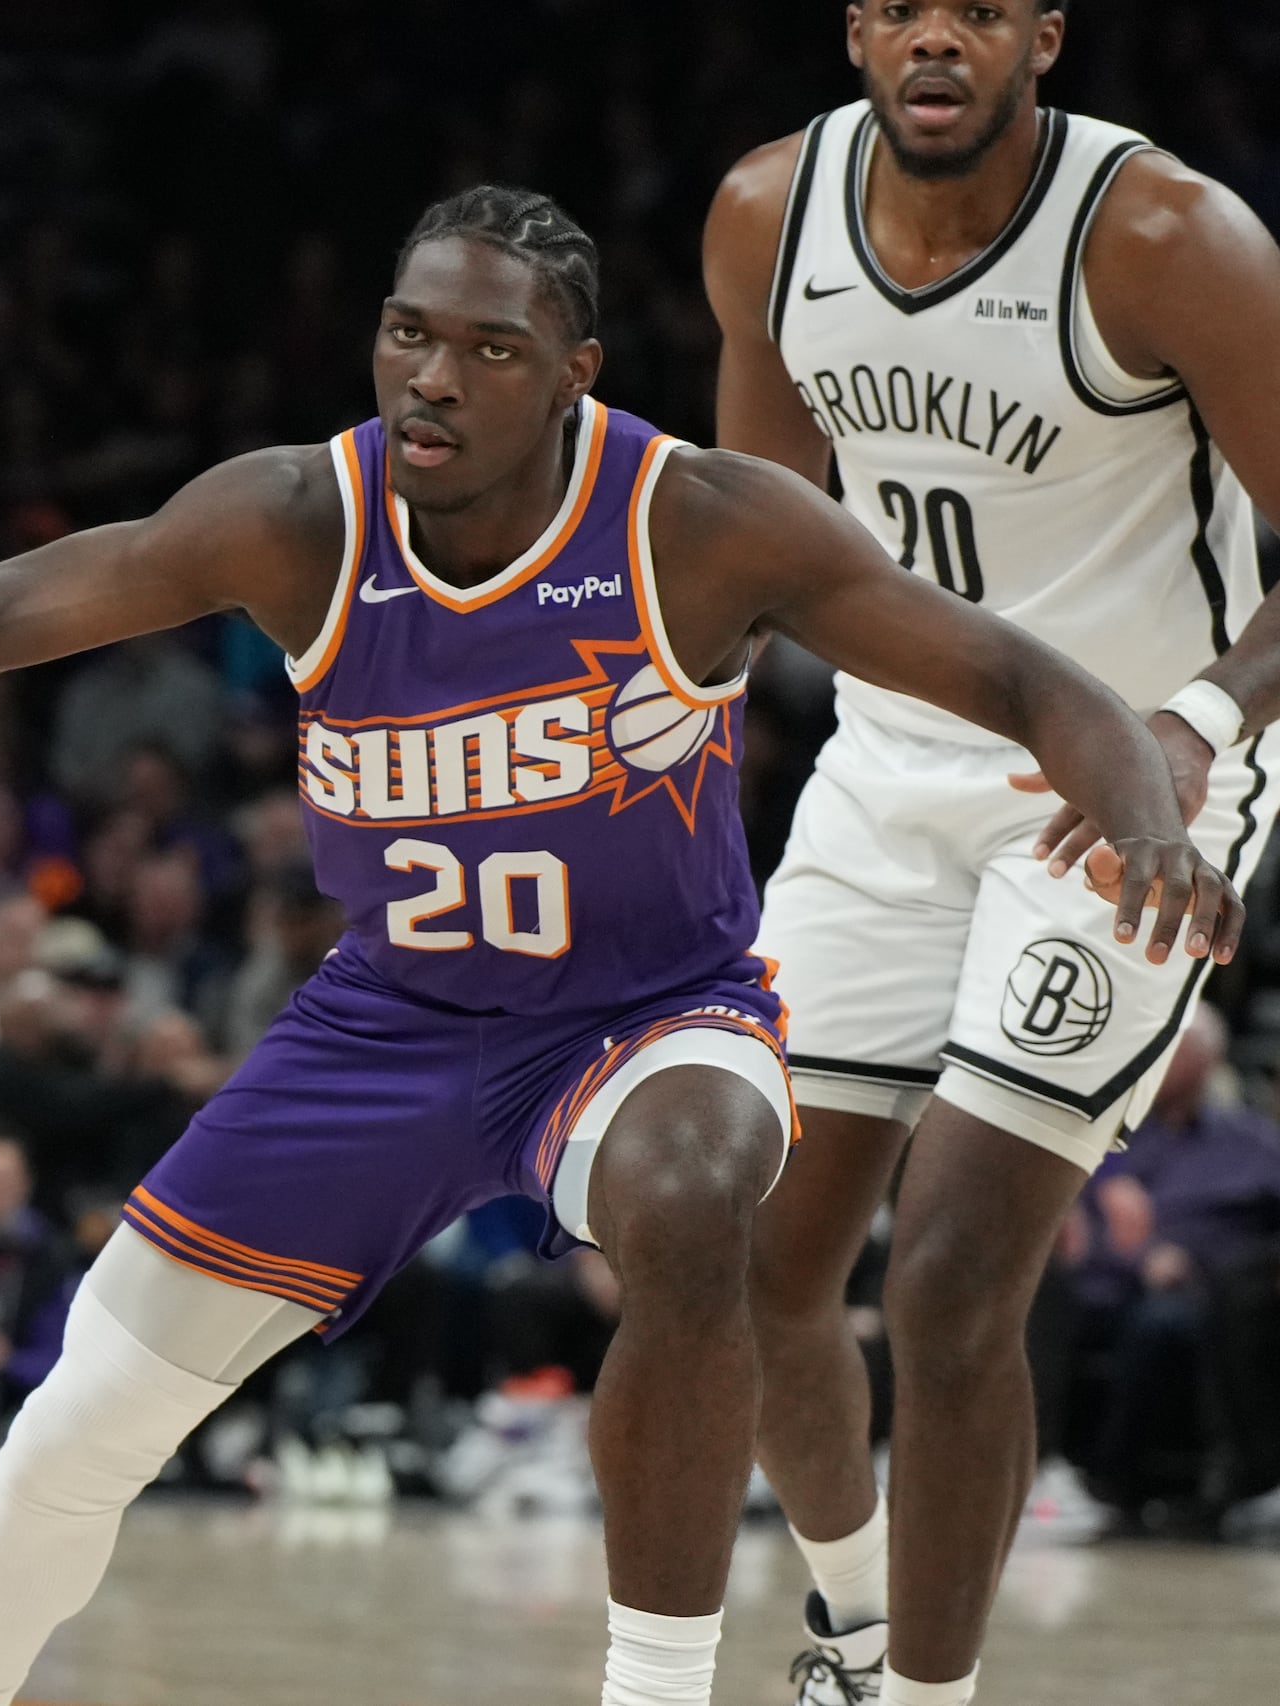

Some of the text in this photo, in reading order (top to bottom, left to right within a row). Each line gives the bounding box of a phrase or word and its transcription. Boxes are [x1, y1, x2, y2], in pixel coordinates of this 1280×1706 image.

[975, 298, 1048, 321] All In Won
[794, 364, 1062, 475] BROOKLYN
[536, 573, 623, 609] PayPal
[877, 479, 985, 604] 20
[383, 837, 572, 959] 20
